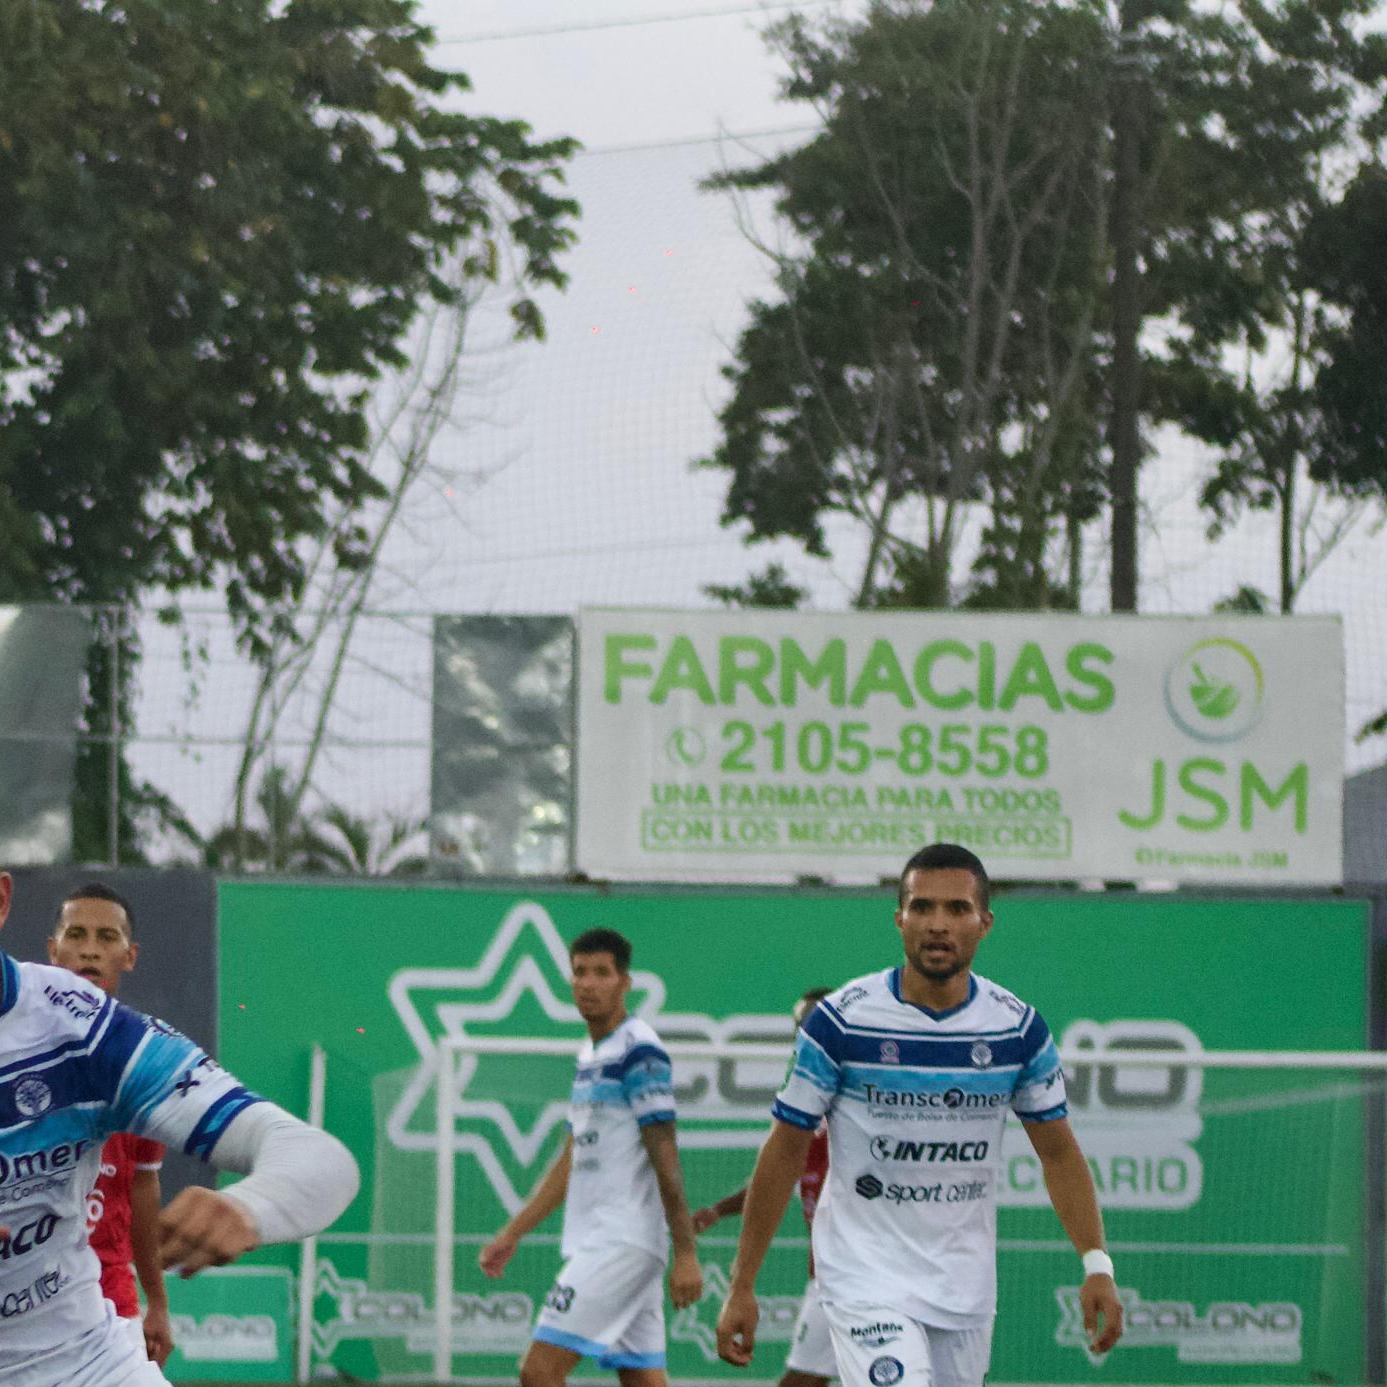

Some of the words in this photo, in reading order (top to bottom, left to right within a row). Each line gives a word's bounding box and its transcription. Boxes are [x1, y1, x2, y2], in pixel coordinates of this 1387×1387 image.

[604, 634, 1115, 714] FARMACIAS
[720, 720, 1049, 778] 2105-8558
[651, 783, 712, 807] UNA
[721, 785, 867, 810] FARMACIA
[877, 787, 955, 811] PARA
[963, 788, 1062, 814] TODOS
[1117, 757, 1307, 834] JSM
[651, 819, 713, 841] CON
[722, 820, 777, 843] LOS
[789, 822, 925, 846] MEJORES
[935, 823, 1060, 848] PRECIOS
[893, 1141, 989, 1162] INTACO
[886, 1183, 943, 1205] sport
[1127, 1308, 1297, 1332] COLONO
